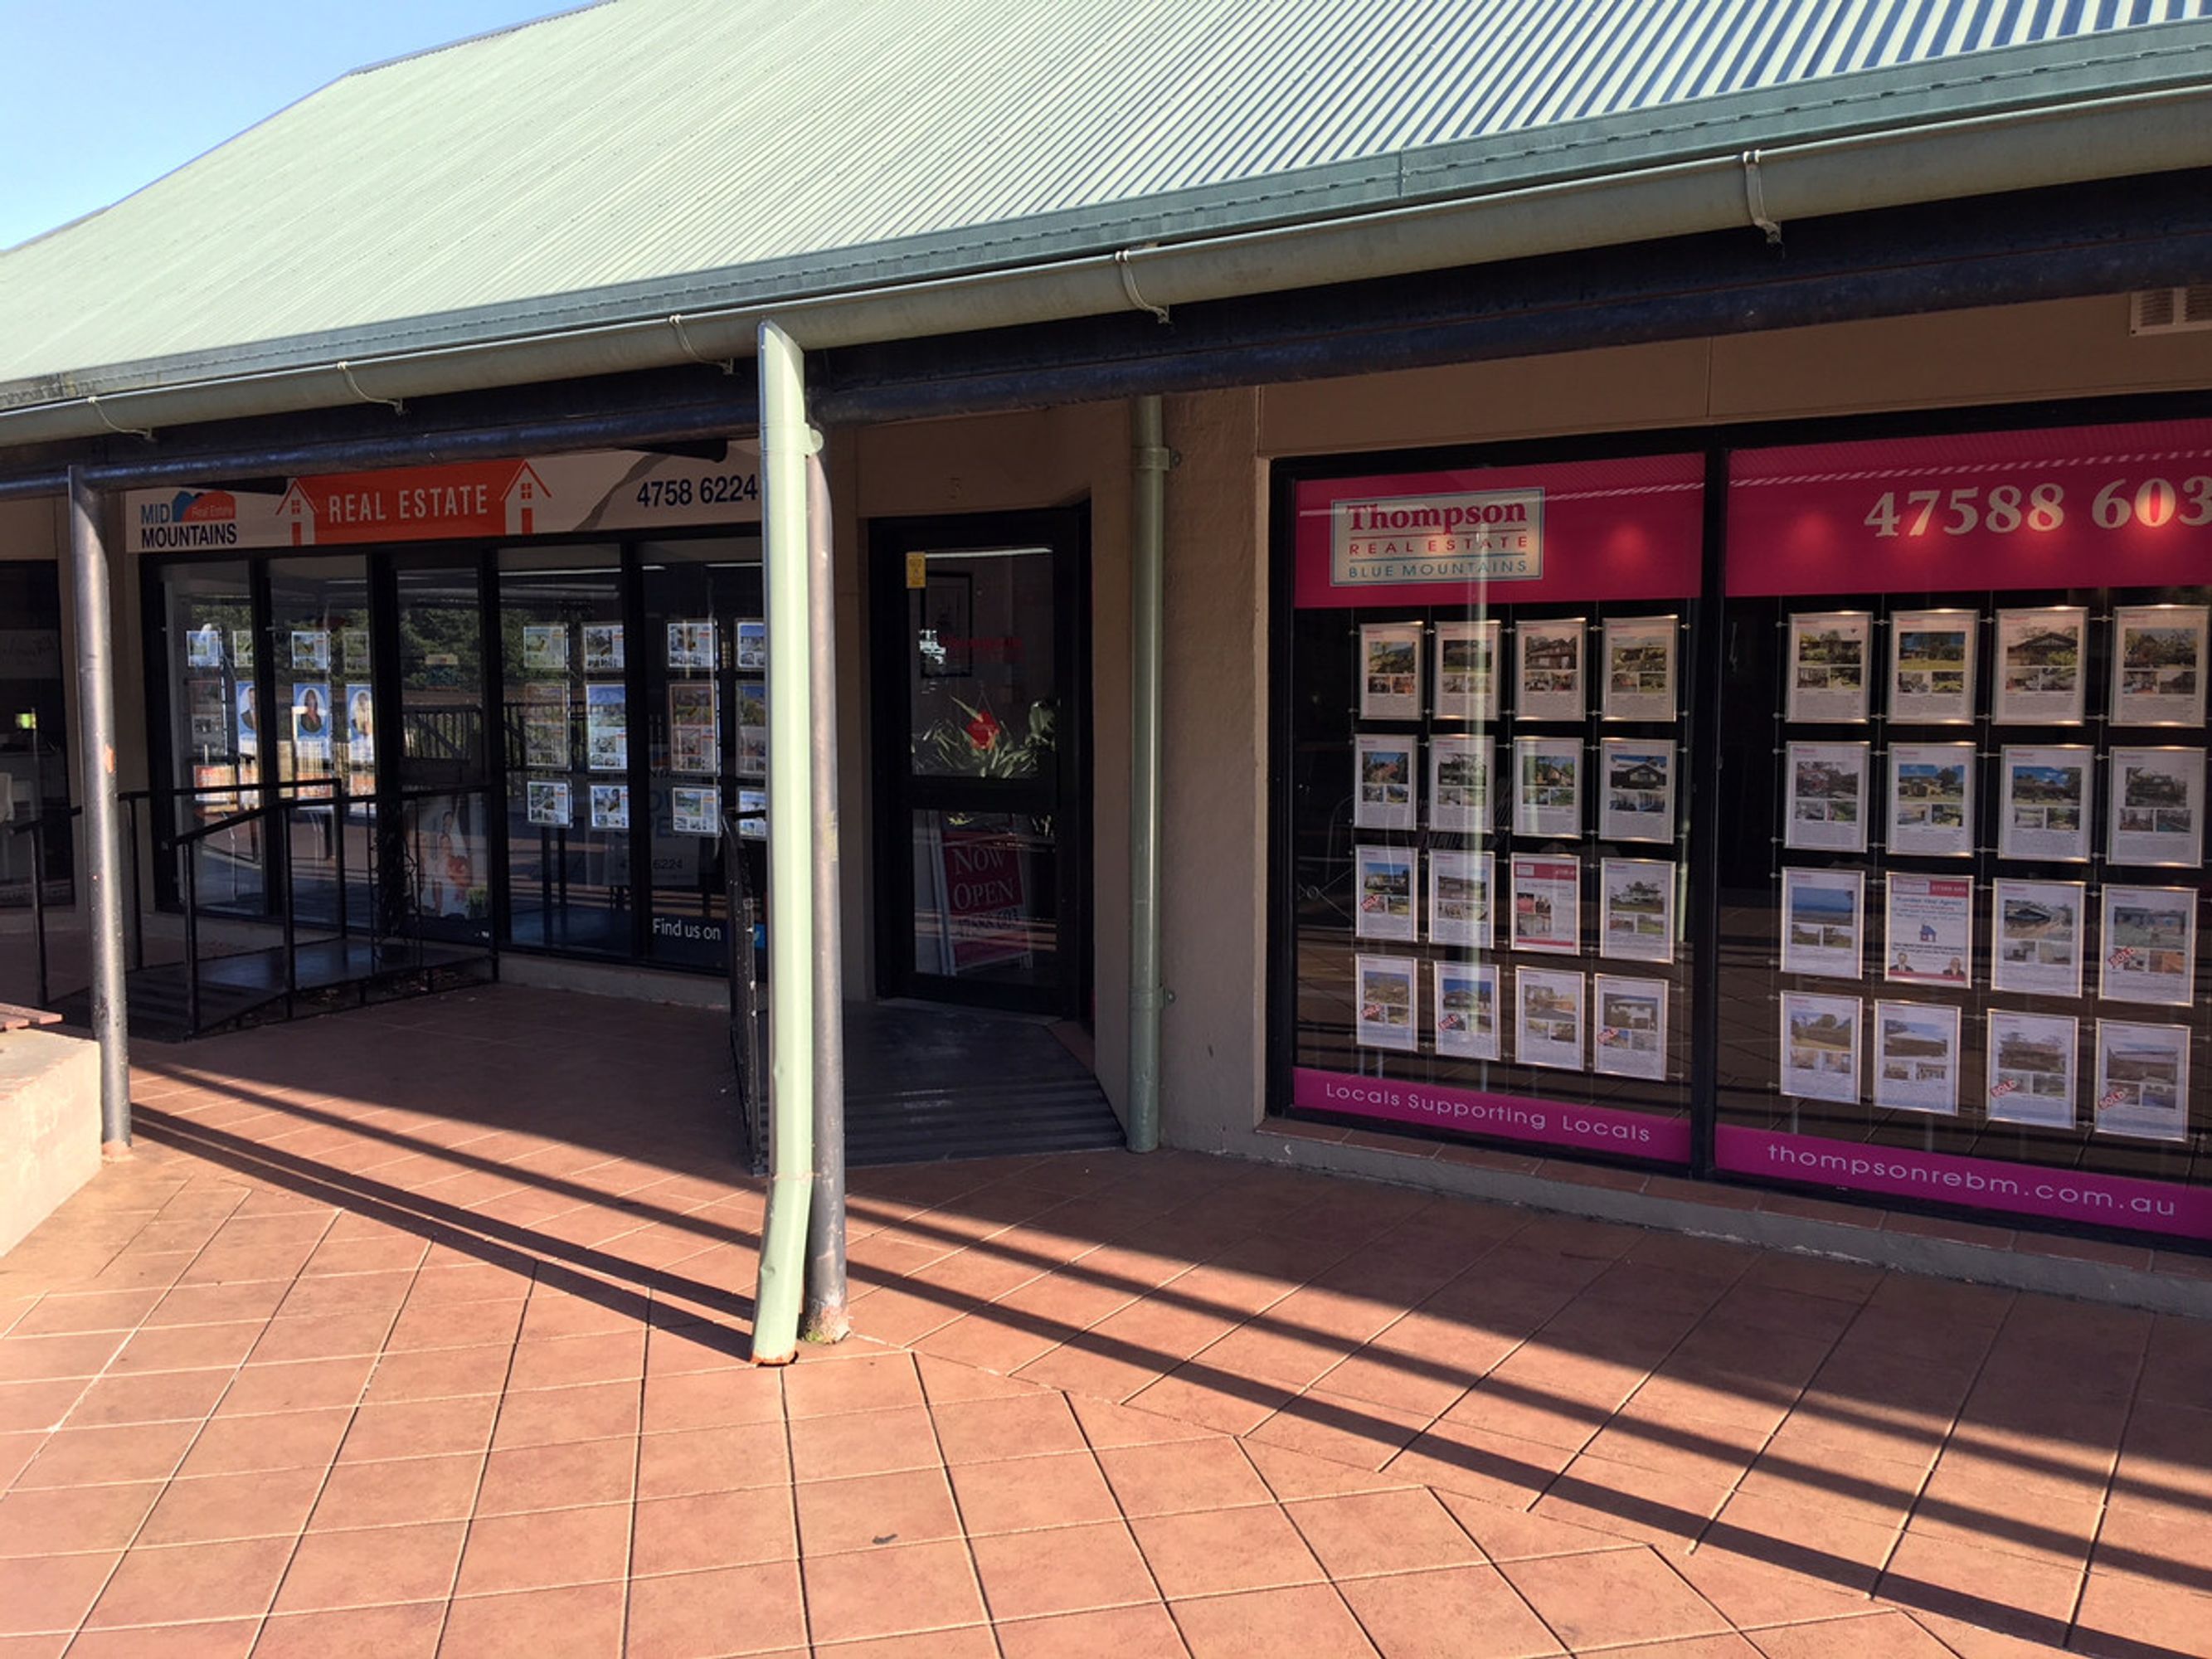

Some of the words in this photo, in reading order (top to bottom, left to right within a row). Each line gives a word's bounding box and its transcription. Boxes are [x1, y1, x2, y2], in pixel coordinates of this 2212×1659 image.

[328, 491, 386, 523] REAL
[398, 484, 488, 519] ESTATE
[637, 479, 693, 507] 4758
[700, 474, 757, 504] 6224
[1864, 483, 2064, 538] 47588
[2092, 475, 2212, 529] 603
[141, 503, 170, 524] MID
[1347, 502, 1527, 535] Thompson
[142, 523, 237, 548] MOUNTAINS
[1349, 542, 1414, 556] REAL
[1427, 536, 1528, 552] ESTATE
[1349, 565, 1393, 578] BLUE
[1403, 560, 1526, 575] MOUNTAINS
[952, 846, 1006, 875] NOW
[954, 878, 1014, 910] OPEN
[652, 917, 682, 937] Find
[685, 925, 701, 939] us
[702, 927, 722, 941] on
[1326, 1082, 1401, 1107] Locals
[1407, 1093, 1547, 1131] Supporting
[1563, 1115, 1651, 1142] Locals
[1767, 1143, 2176, 1216] thompsonrebm.com.au
